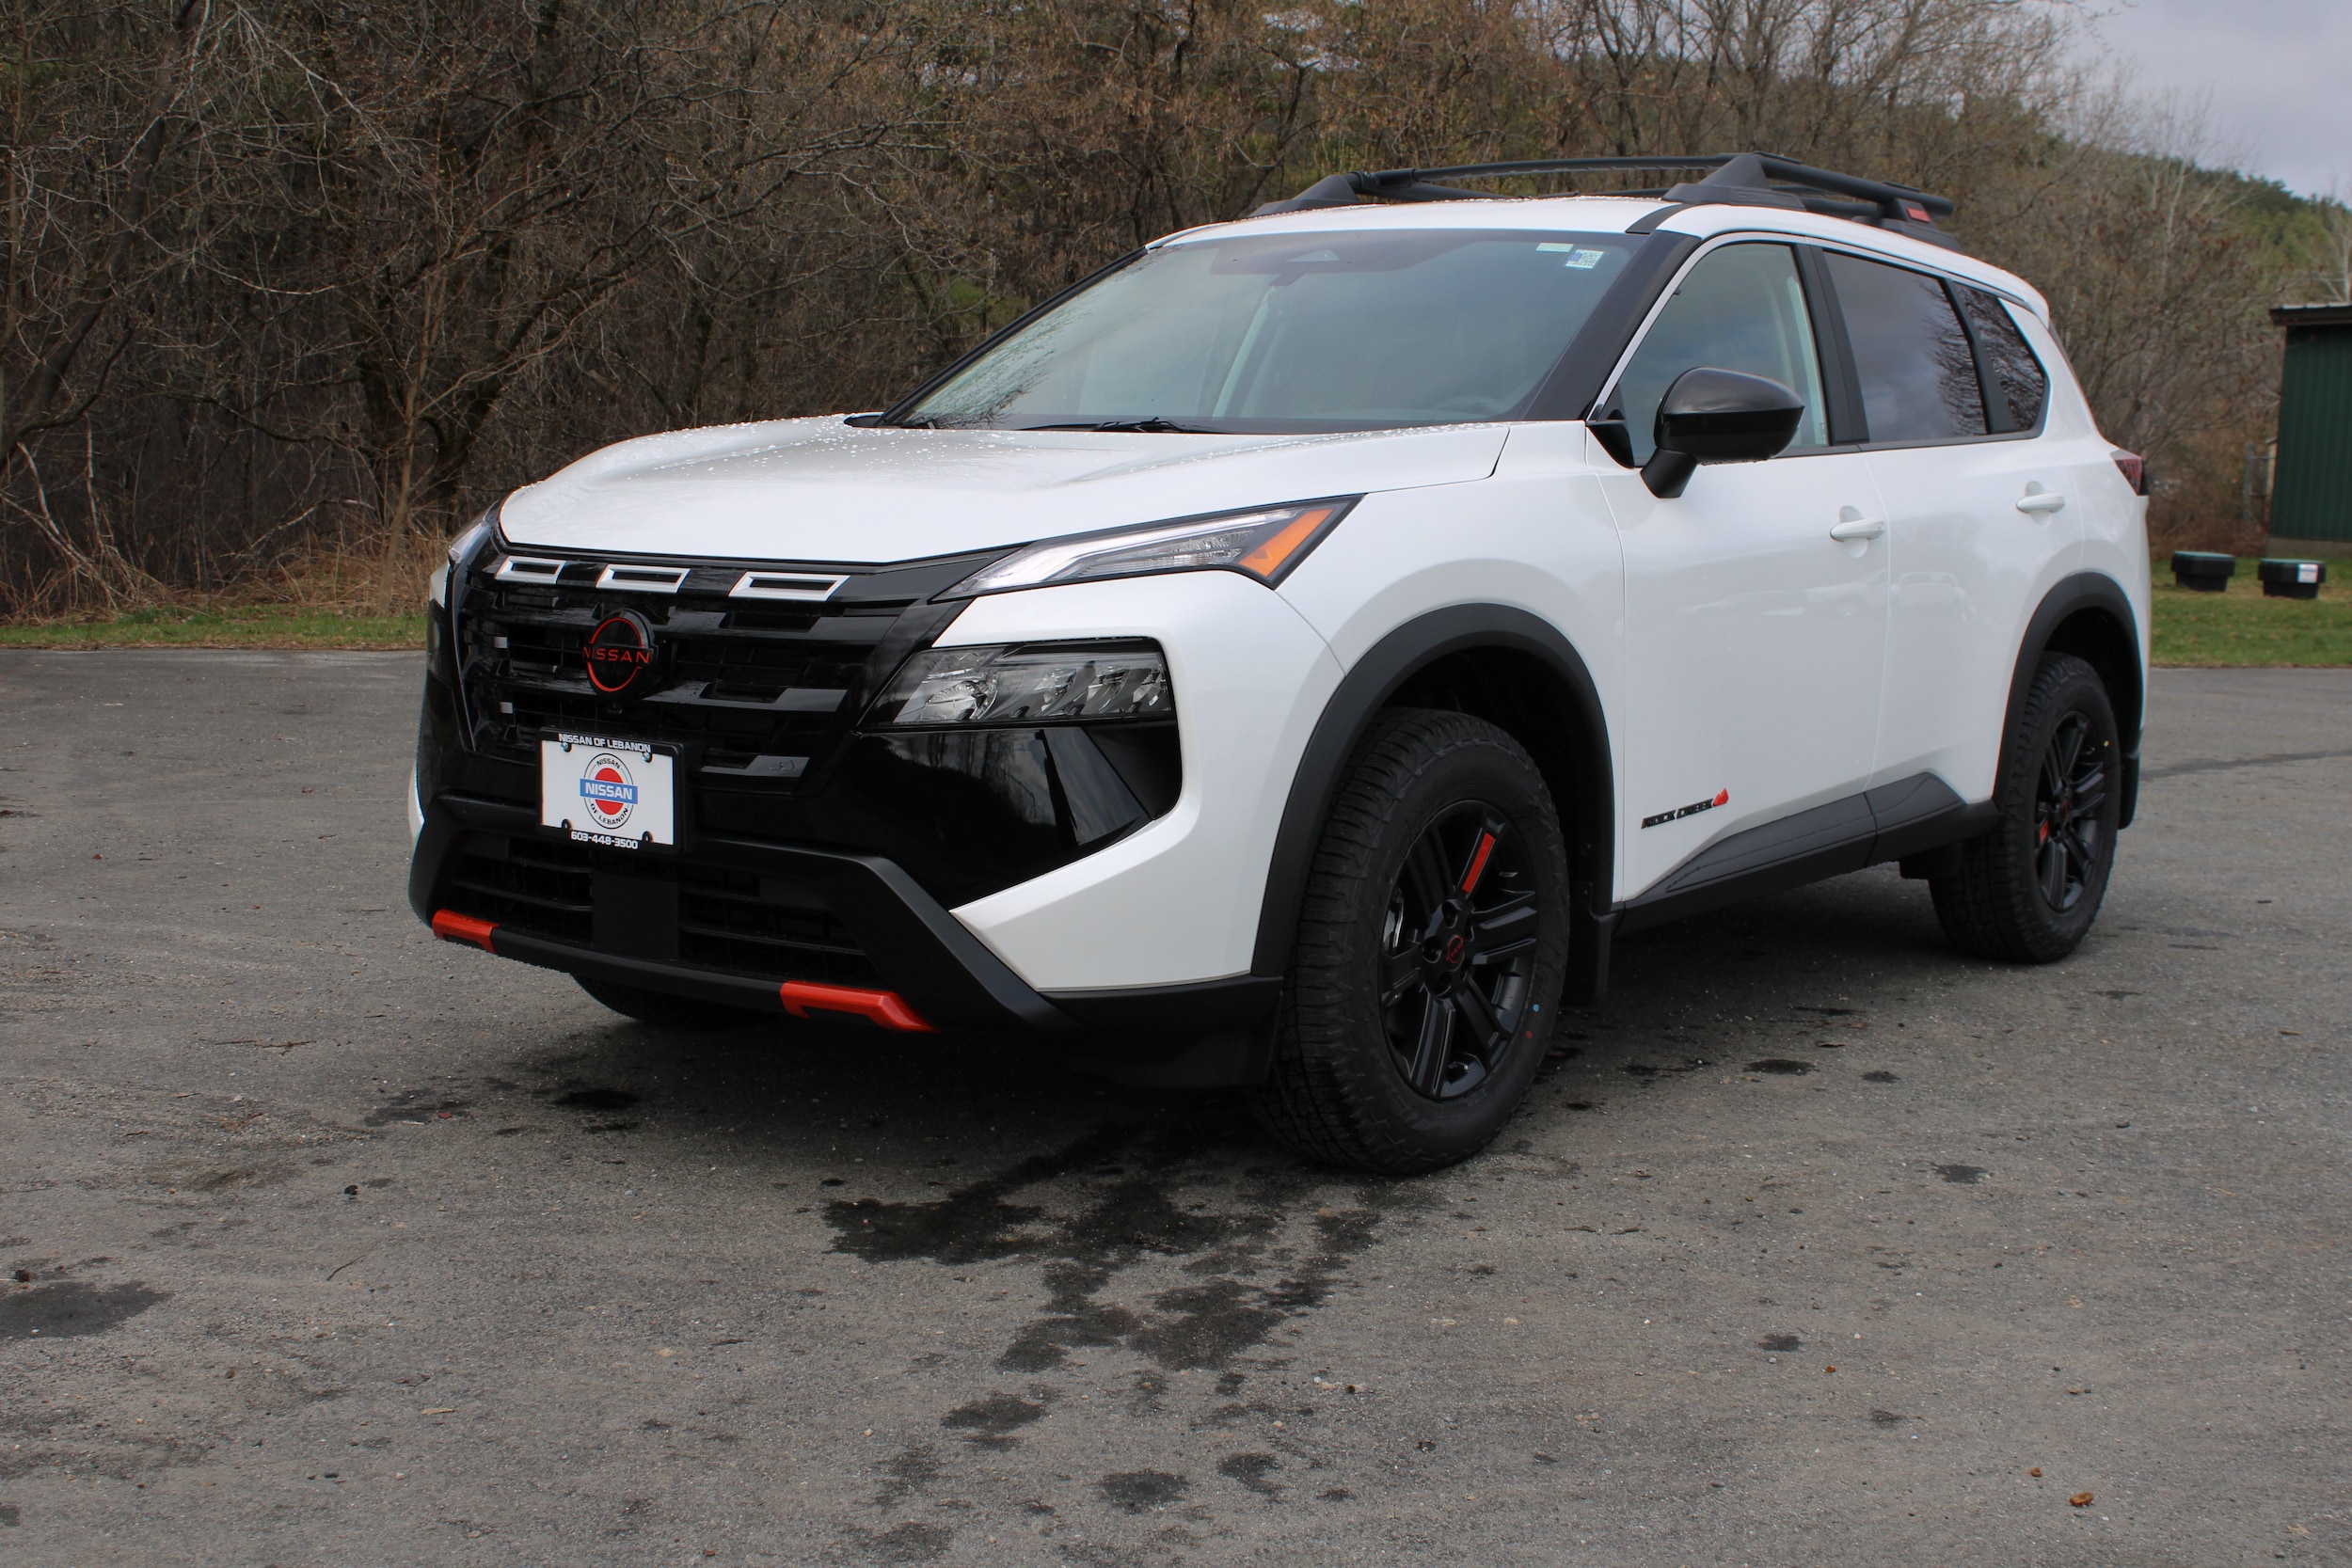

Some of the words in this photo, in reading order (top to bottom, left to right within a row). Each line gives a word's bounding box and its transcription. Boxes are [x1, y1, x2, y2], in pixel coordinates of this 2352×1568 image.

[582, 646, 651, 664] NISSAN
[558, 733, 593, 747] NISSAN
[594, 737, 606, 747] OF
[607, 738, 651, 752] LEBANON
[596, 757, 621, 769] NISSAN
[585, 782, 633, 800] NISSAN
[590, 803, 599, 814] OF
[598, 807, 628, 825] LEBANON
[570, 831, 639, 850] 603-448-3500
